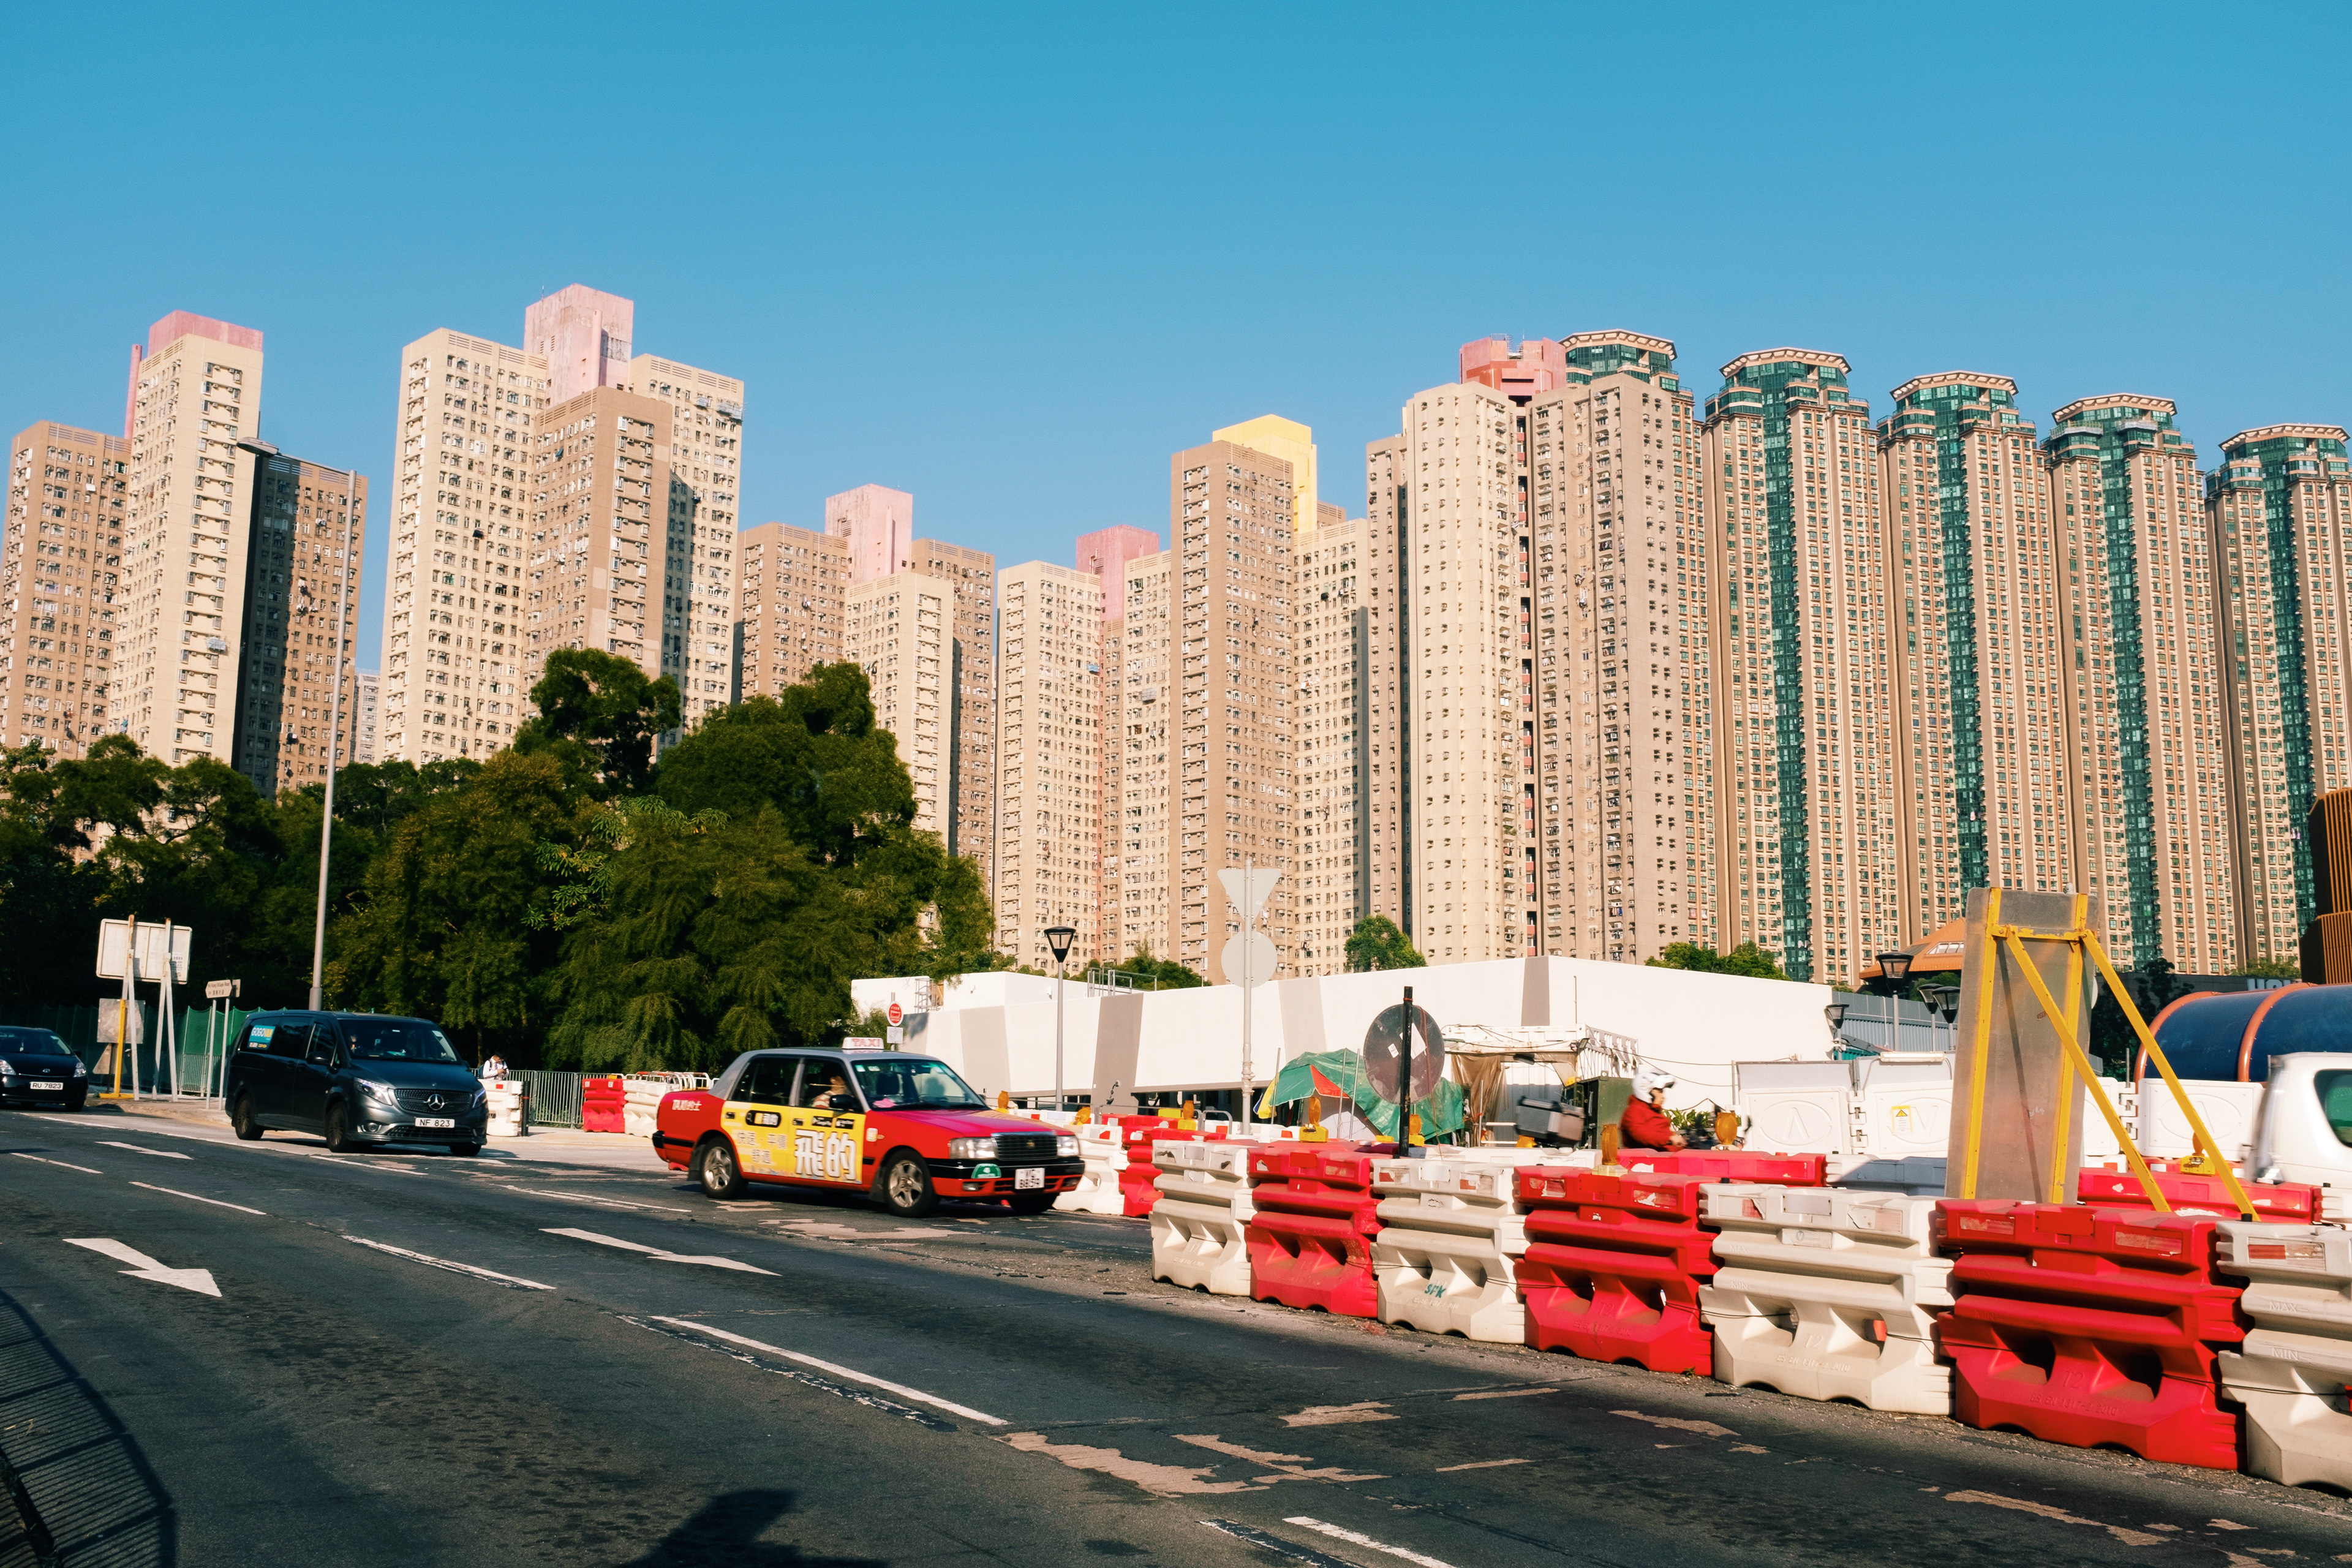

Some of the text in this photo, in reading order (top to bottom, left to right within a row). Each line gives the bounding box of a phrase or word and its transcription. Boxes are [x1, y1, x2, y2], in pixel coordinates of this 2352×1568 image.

[852, 1038, 881, 1047] TAXI
[794, 1128, 856, 1181] 飛的
[2269, 1300, 2297, 1313] MAX
[2272, 1347, 2299, 1361] MIN
